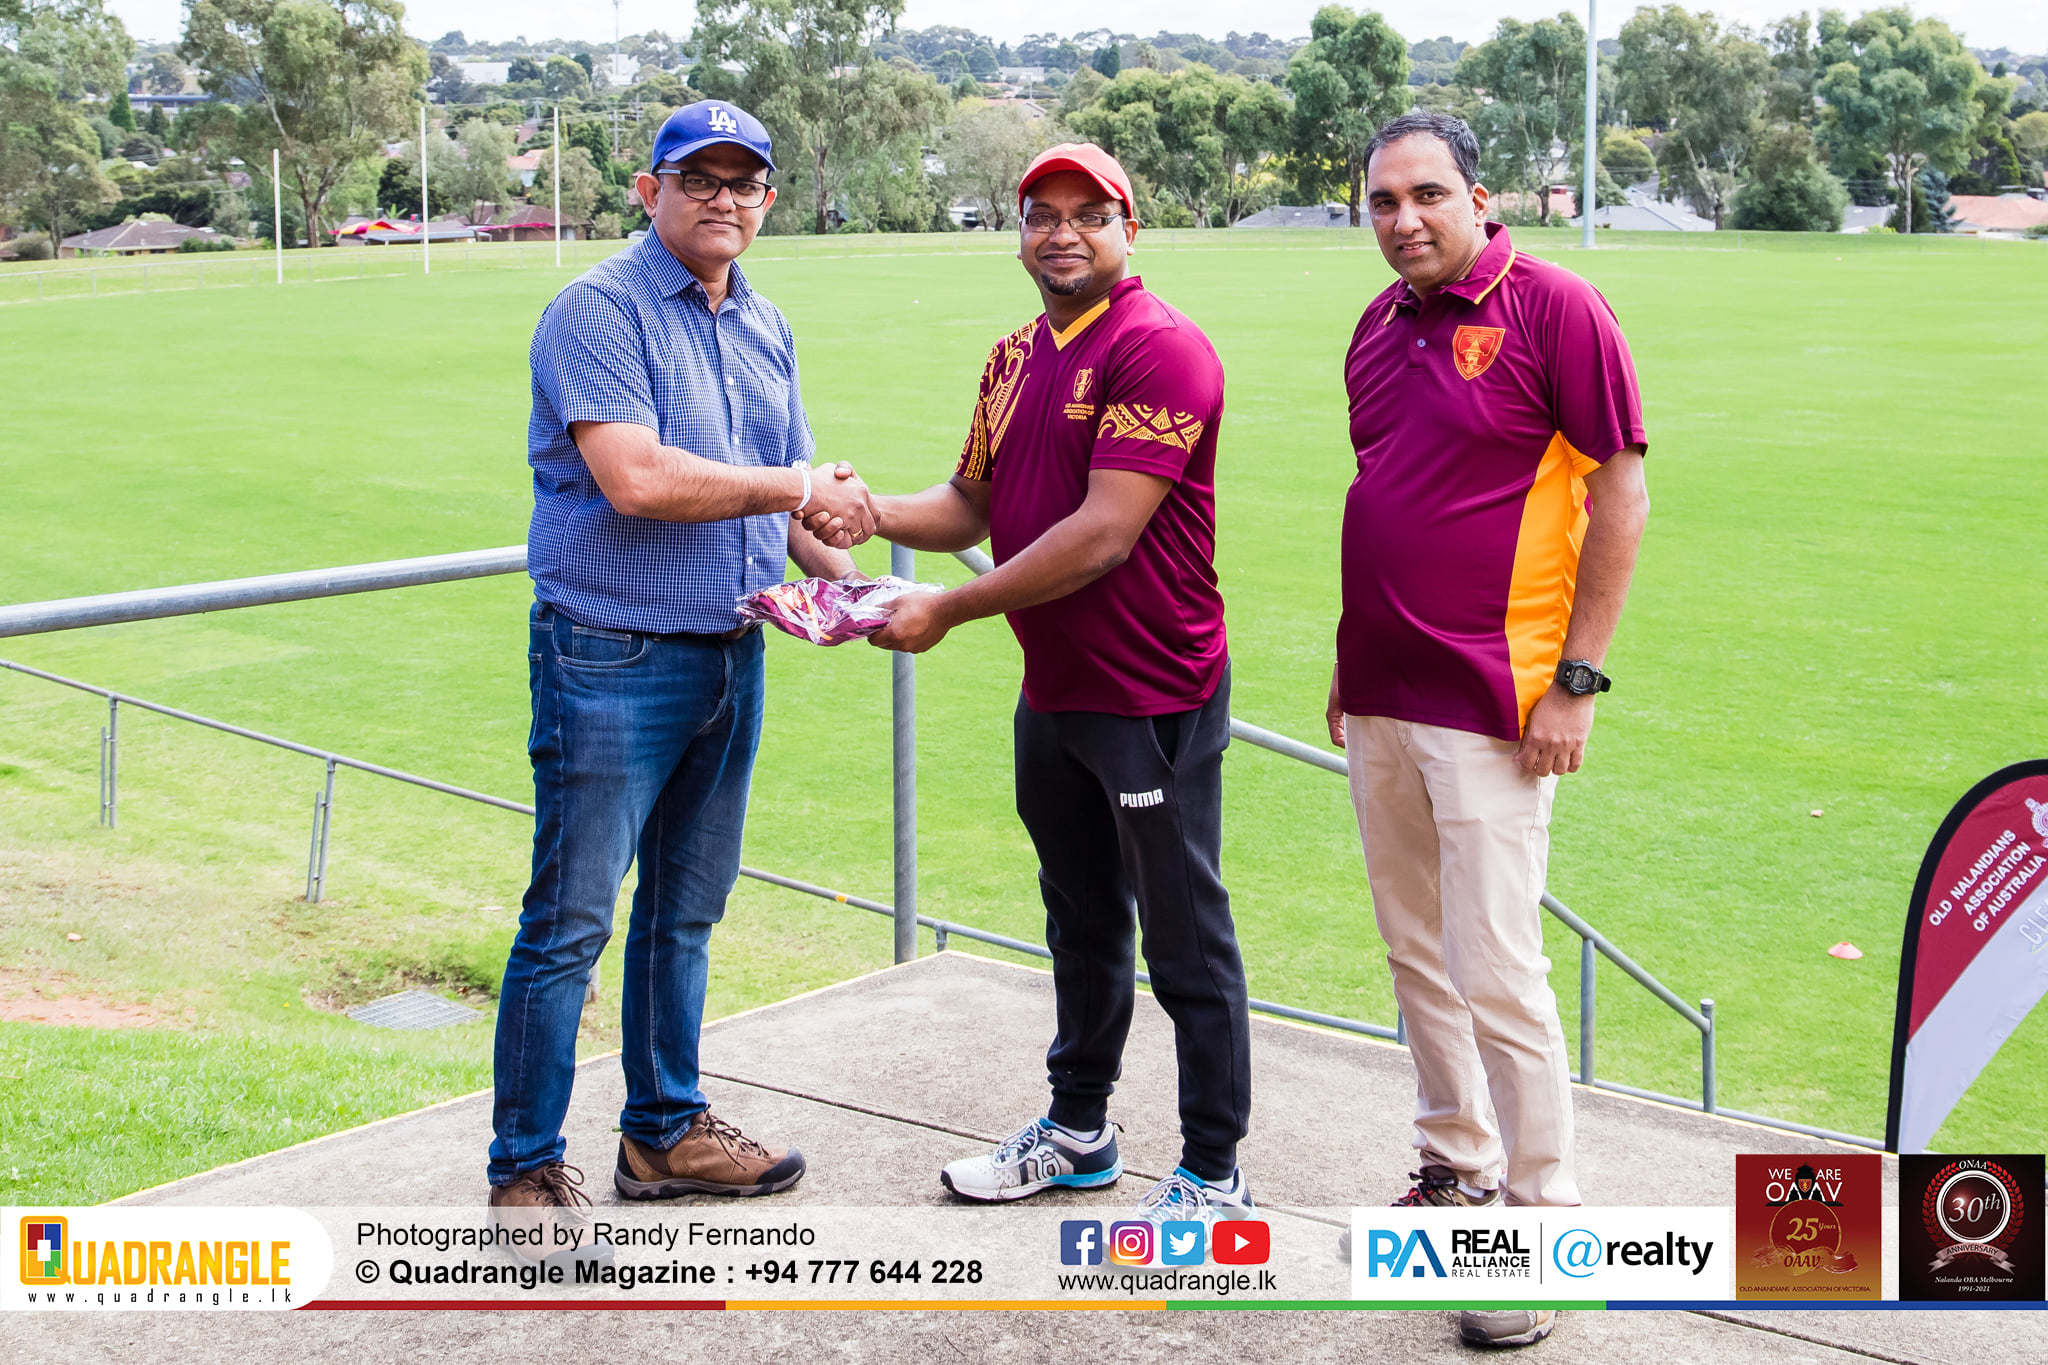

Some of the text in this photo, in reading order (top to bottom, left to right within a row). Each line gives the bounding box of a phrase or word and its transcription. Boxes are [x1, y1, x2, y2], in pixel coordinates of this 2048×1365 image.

[708, 106, 737, 135] LA
[1120, 788, 1164, 808] PUMA
[1929, 829, 2017, 926] OLD NALANDIANS
[1963, 841, 2032, 916] ASSOCIATION
[1973, 855, 2047, 932] OF AUSTRALIA
